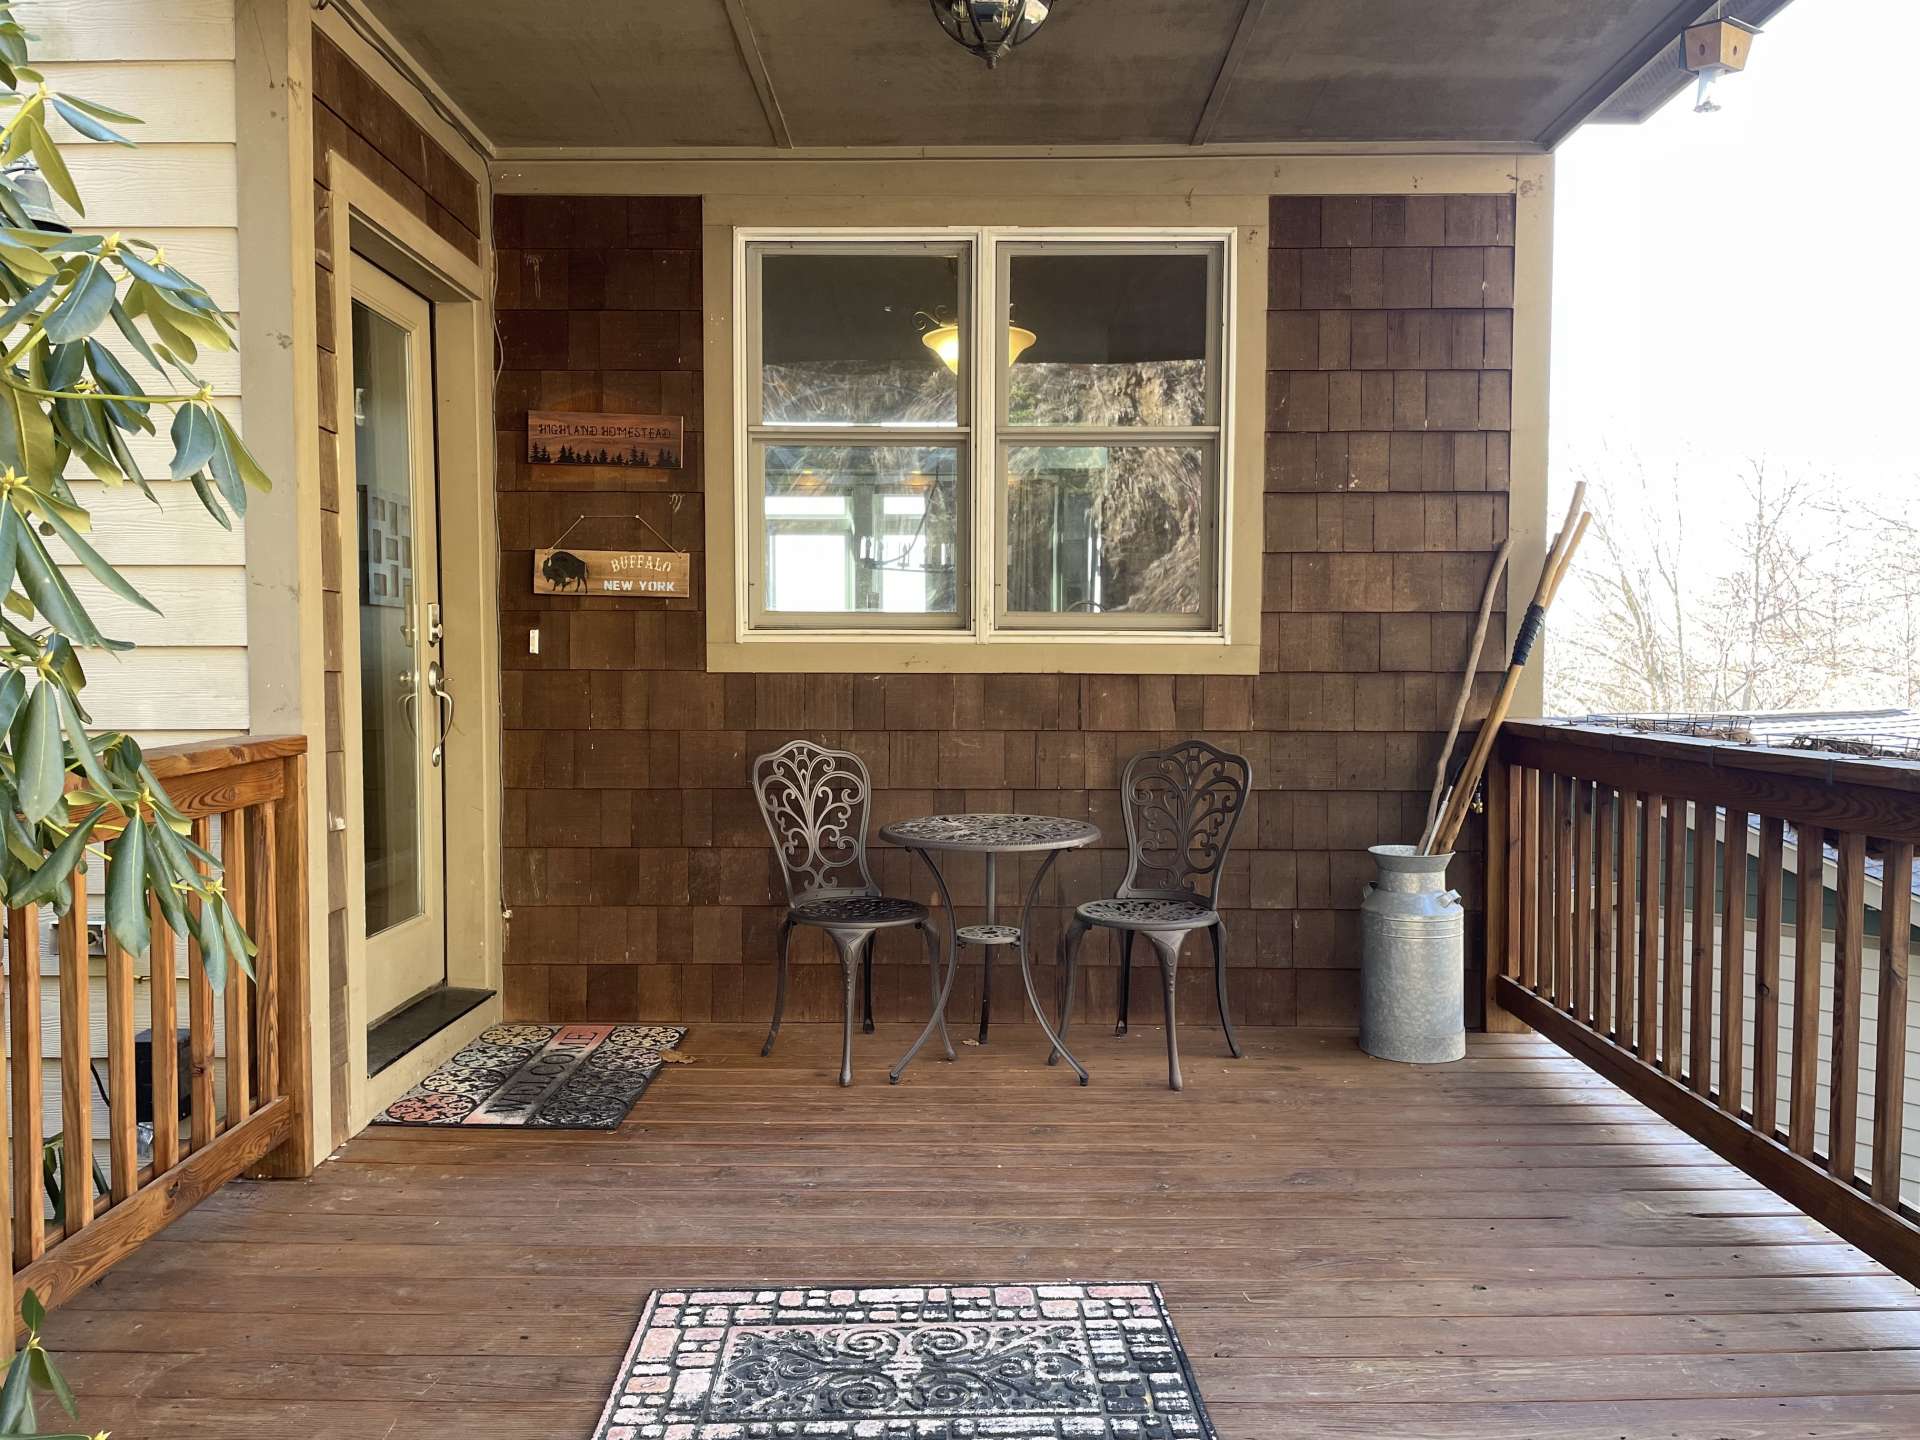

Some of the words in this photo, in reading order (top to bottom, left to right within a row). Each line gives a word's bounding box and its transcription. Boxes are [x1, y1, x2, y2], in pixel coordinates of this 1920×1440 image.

[538, 423, 598, 438] HIGHLAND
[601, 425, 672, 439] HOMESTEAD
[611, 553, 673, 574] BUFFALO
[603, 579, 634, 592] NEW
[639, 580, 676, 593] YORK
[484, 1031, 599, 1114] WELCOME
